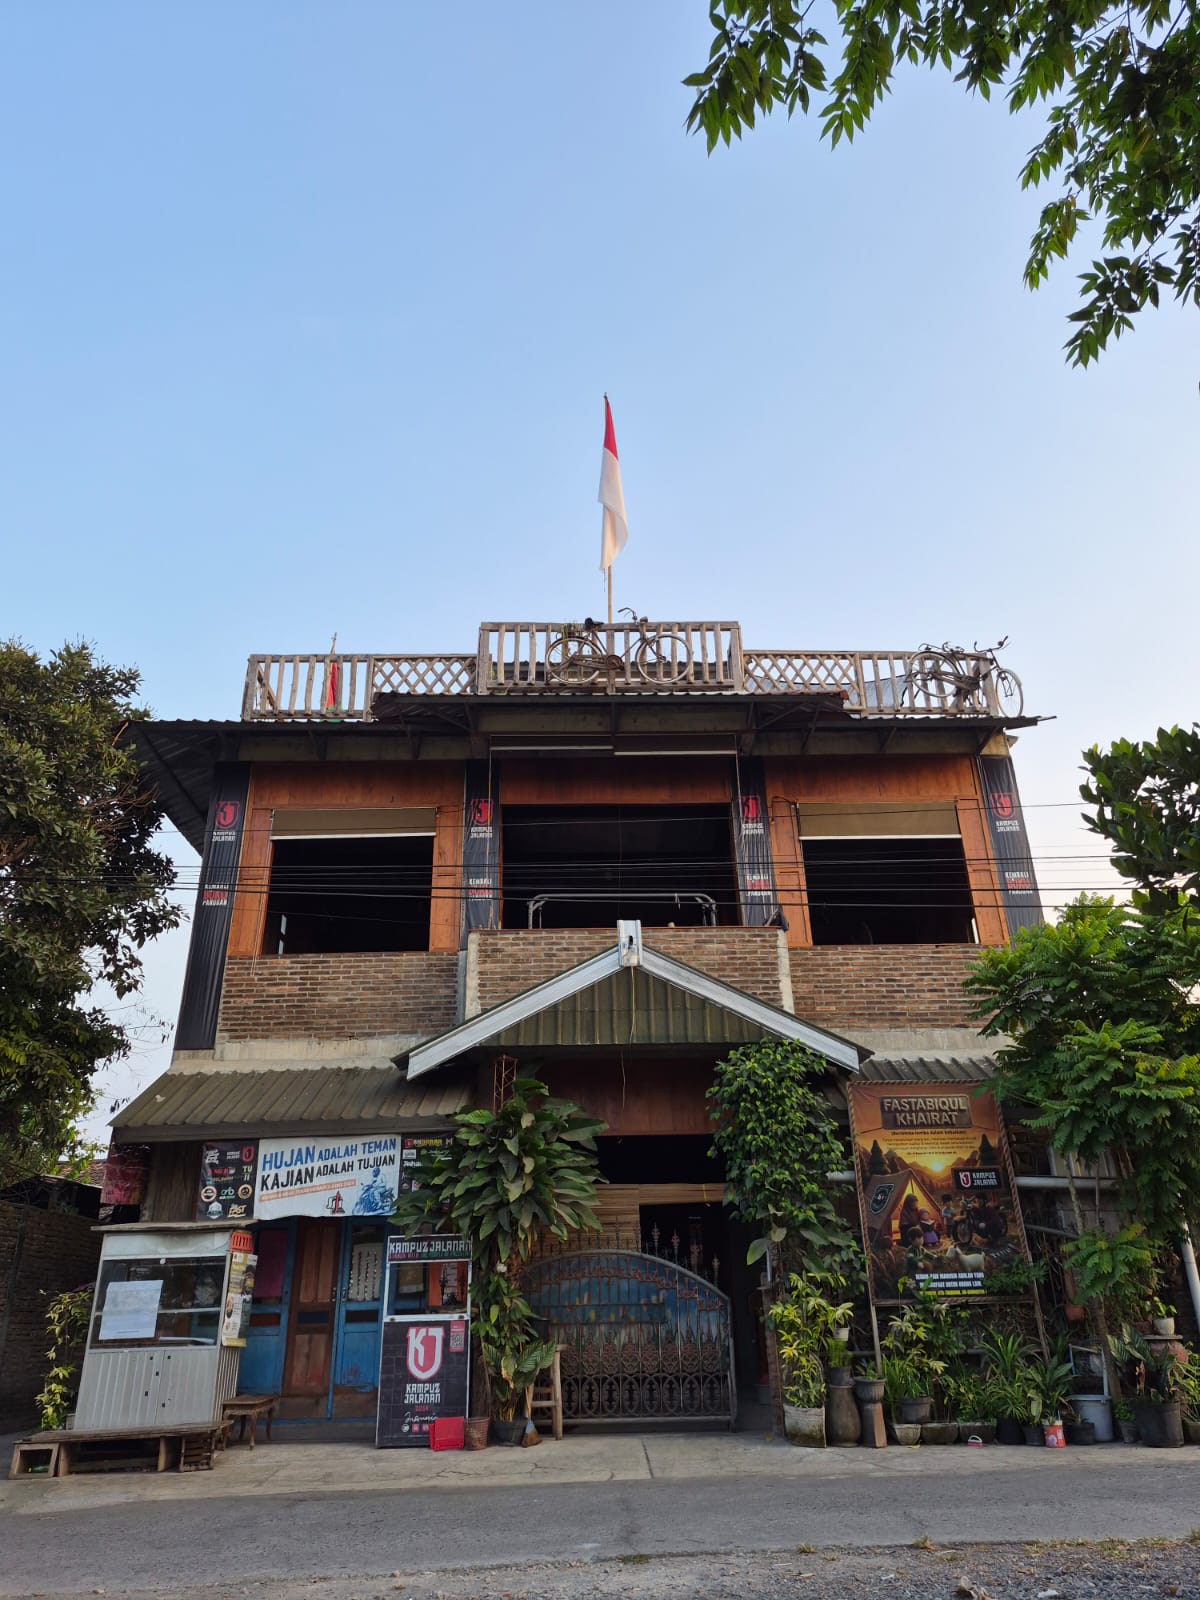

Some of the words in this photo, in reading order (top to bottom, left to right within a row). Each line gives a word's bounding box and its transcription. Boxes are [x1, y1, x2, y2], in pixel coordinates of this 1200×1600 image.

[883, 1097, 968, 1111] FASTABIQUL
[896, 1111, 958, 1125] KHAIRAT
[262, 1145, 316, 1171] HUJAN
[317, 1143, 358, 1161] ADALAH
[361, 1138, 397, 1155] TEMAN
[260, 1166, 315, 1192] KAJIAN
[316, 1160, 354, 1177] ADALAH
[357, 1154, 396, 1170] TUJUAN
[389, 1242, 428, 1253] KAMPUZ
[430, 1240, 472, 1252] JALANAN
[405, 1383, 440, 1394] KAMPUZ
[403, 1393, 441, 1404] JALANAN
